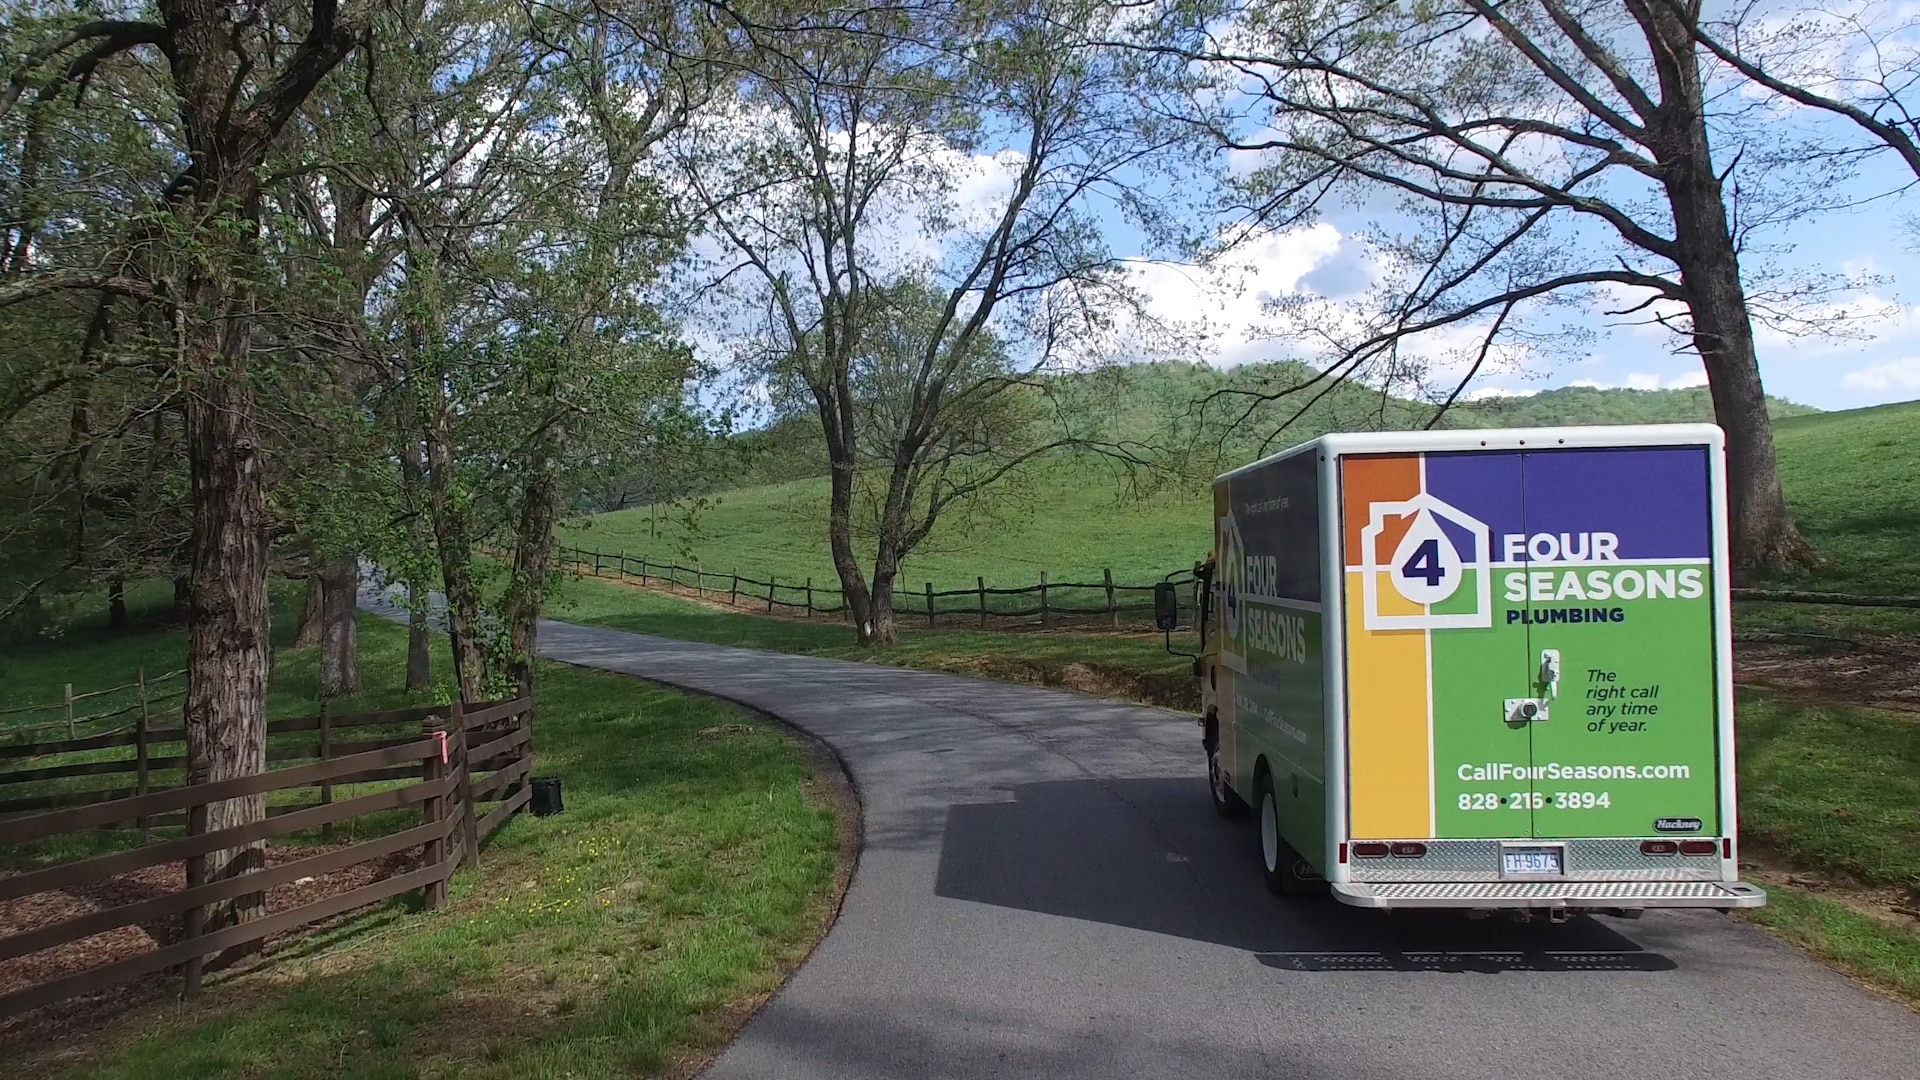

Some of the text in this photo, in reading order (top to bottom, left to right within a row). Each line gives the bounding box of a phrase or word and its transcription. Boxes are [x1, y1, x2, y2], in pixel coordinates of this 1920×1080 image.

[1504, 531, 1619, 563] FOUR
[1401, 539, 1445, 586] 4
[1246, 555, 1278, 598] FOUR
[1504, 569, 1704, 602] SEASONS
[1506, 607, 1625, 625] PLUMBING
[1249, 607, 1306, 665] SEASONS
[1587, 669, 1617, 682] The
[1586, 685, 1659, 701] right call
[1586, 702, 1658, 718] any time
[1587, 718, 1647, 735] of year.
[1457, 763, 1690, 781] CallFourSeasons.com
[1657, 819, 1700, 831] Hackney
